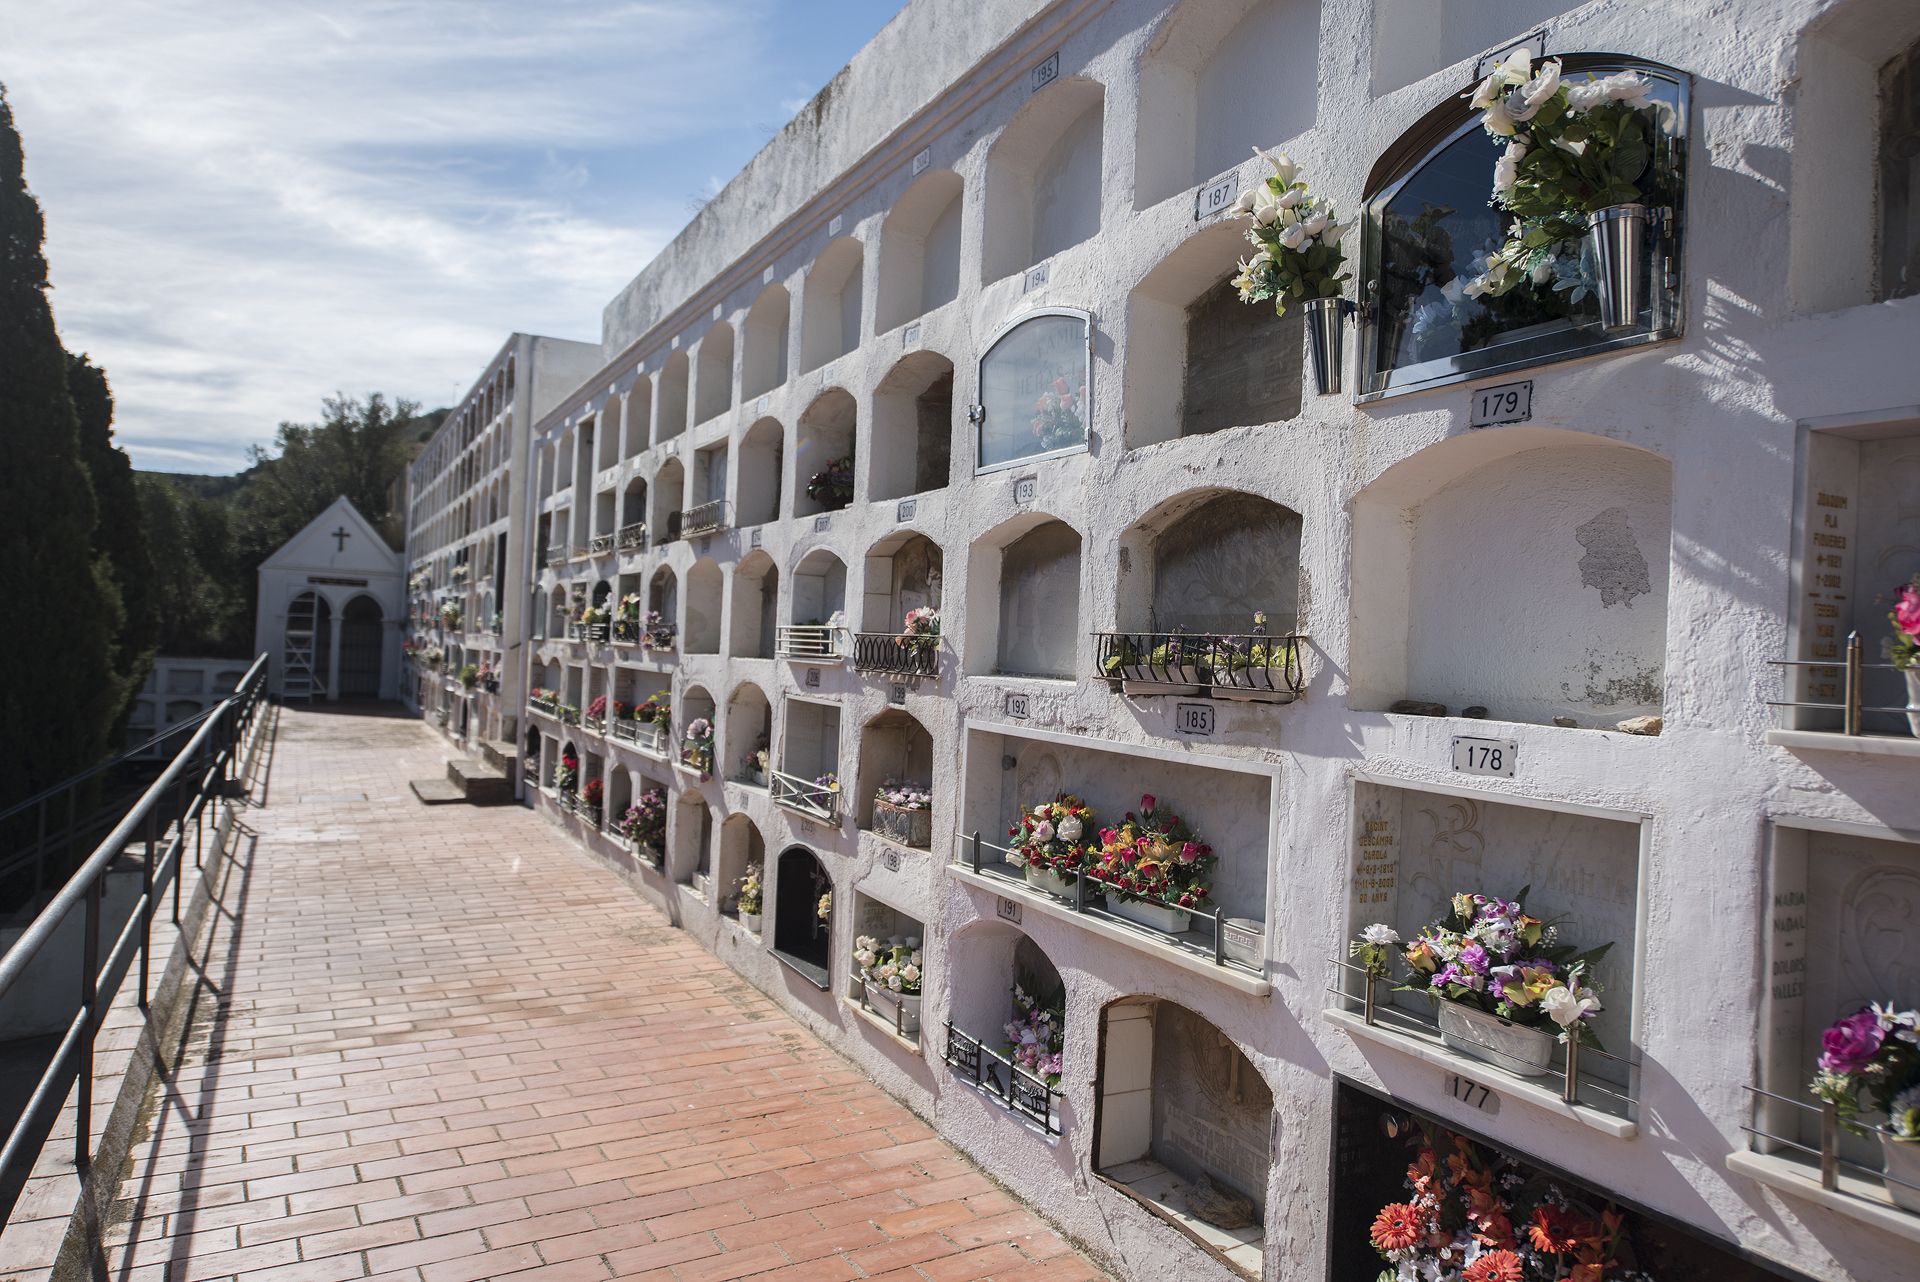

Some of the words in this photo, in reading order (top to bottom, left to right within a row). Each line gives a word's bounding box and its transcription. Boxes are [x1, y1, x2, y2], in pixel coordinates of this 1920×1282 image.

[1038, 61, 1053, 83] 195
[1209, 184, 1230, 209] 187
[1032, 269, 1046, 288] 194
[1482, 391, 1518, 418] 179
[1019, 483, 1033, 498] 193
[894, 686, 905, 699] 199
[1012, 699, 1026, 715] 192
[1186, 709, 1207, 729] 185
[1468, 745, 1503, 771] 178
[887, 854, 898, 868] 198
[1004, 900, 1016, 917] 191
[1454, 1076, 1489, 1108] 177
